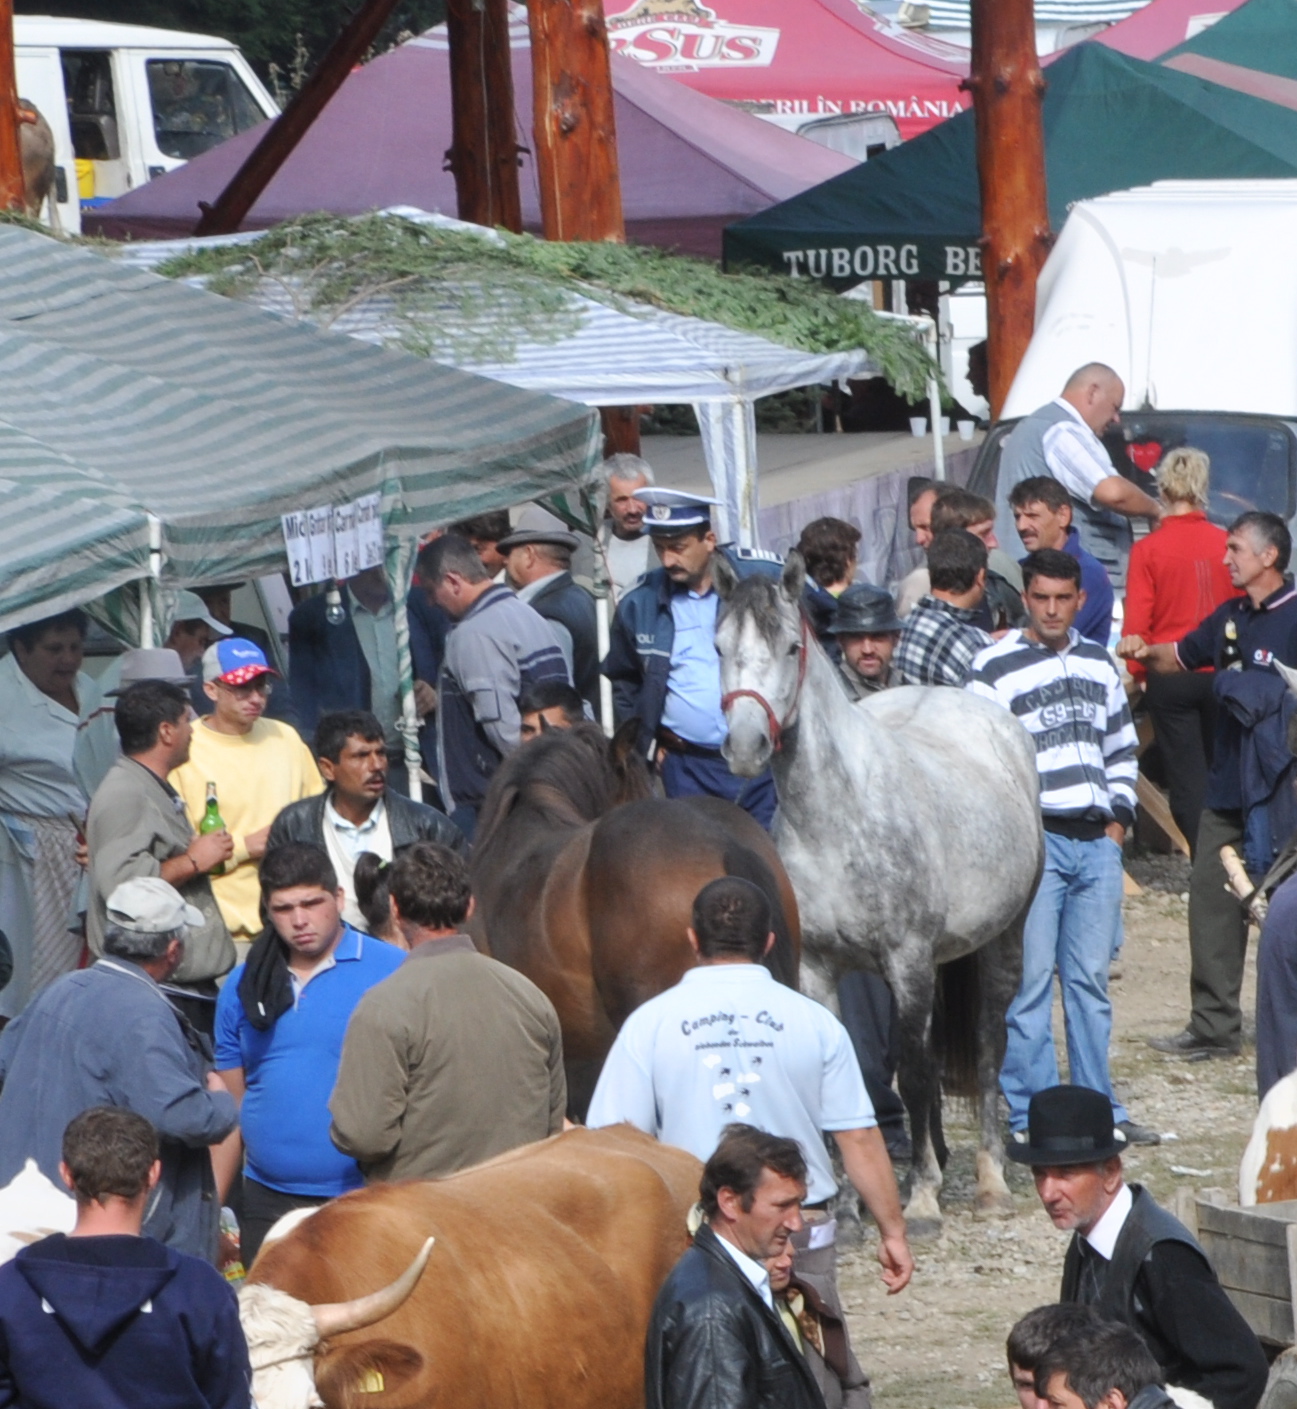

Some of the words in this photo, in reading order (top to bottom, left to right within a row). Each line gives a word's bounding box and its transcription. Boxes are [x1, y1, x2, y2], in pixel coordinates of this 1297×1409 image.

[610, 27, 762, 63] RSUS
[817, 95, 842, 114] ÎN
[850, 95, 964, 119] ROMÂNIA
[782, 244, 920, 278] TUBORG
[945, 246, 982, 276] BE
[681, 1011, 735, 1036] Camping
[756, 1010, 784, 1032] Club
